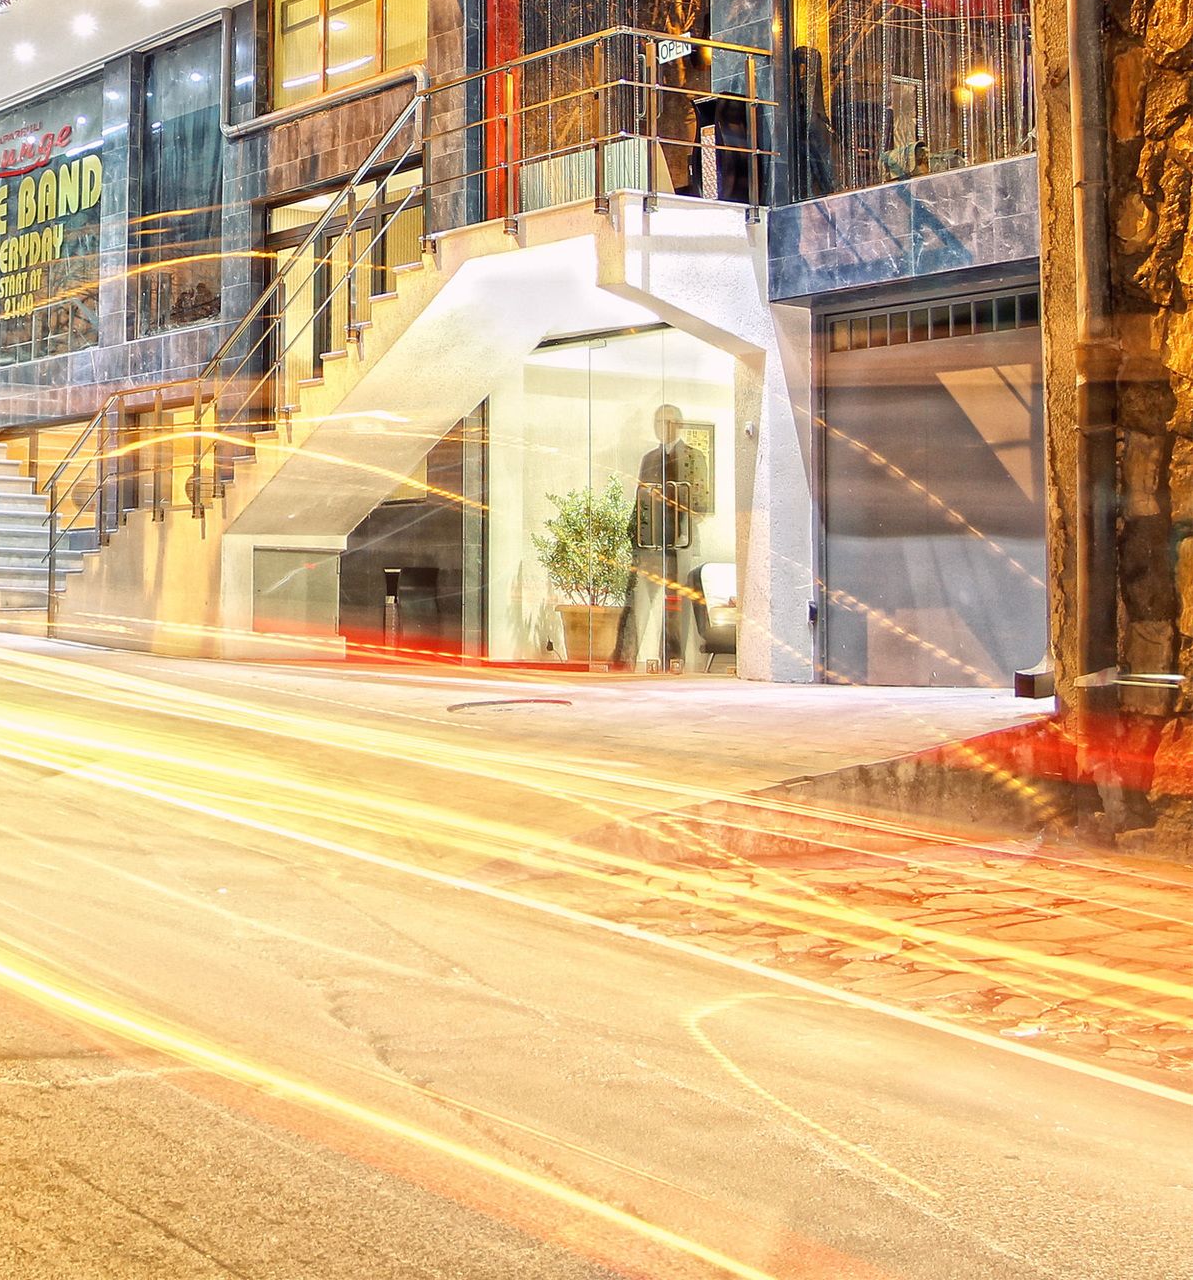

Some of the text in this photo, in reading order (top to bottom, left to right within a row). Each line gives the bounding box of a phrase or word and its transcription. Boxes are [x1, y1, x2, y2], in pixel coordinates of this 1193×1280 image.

[660, 38, 689, 60] OPEN
[17, 154, 103, 230] BAND
[29, 268, 43, 292] AT
